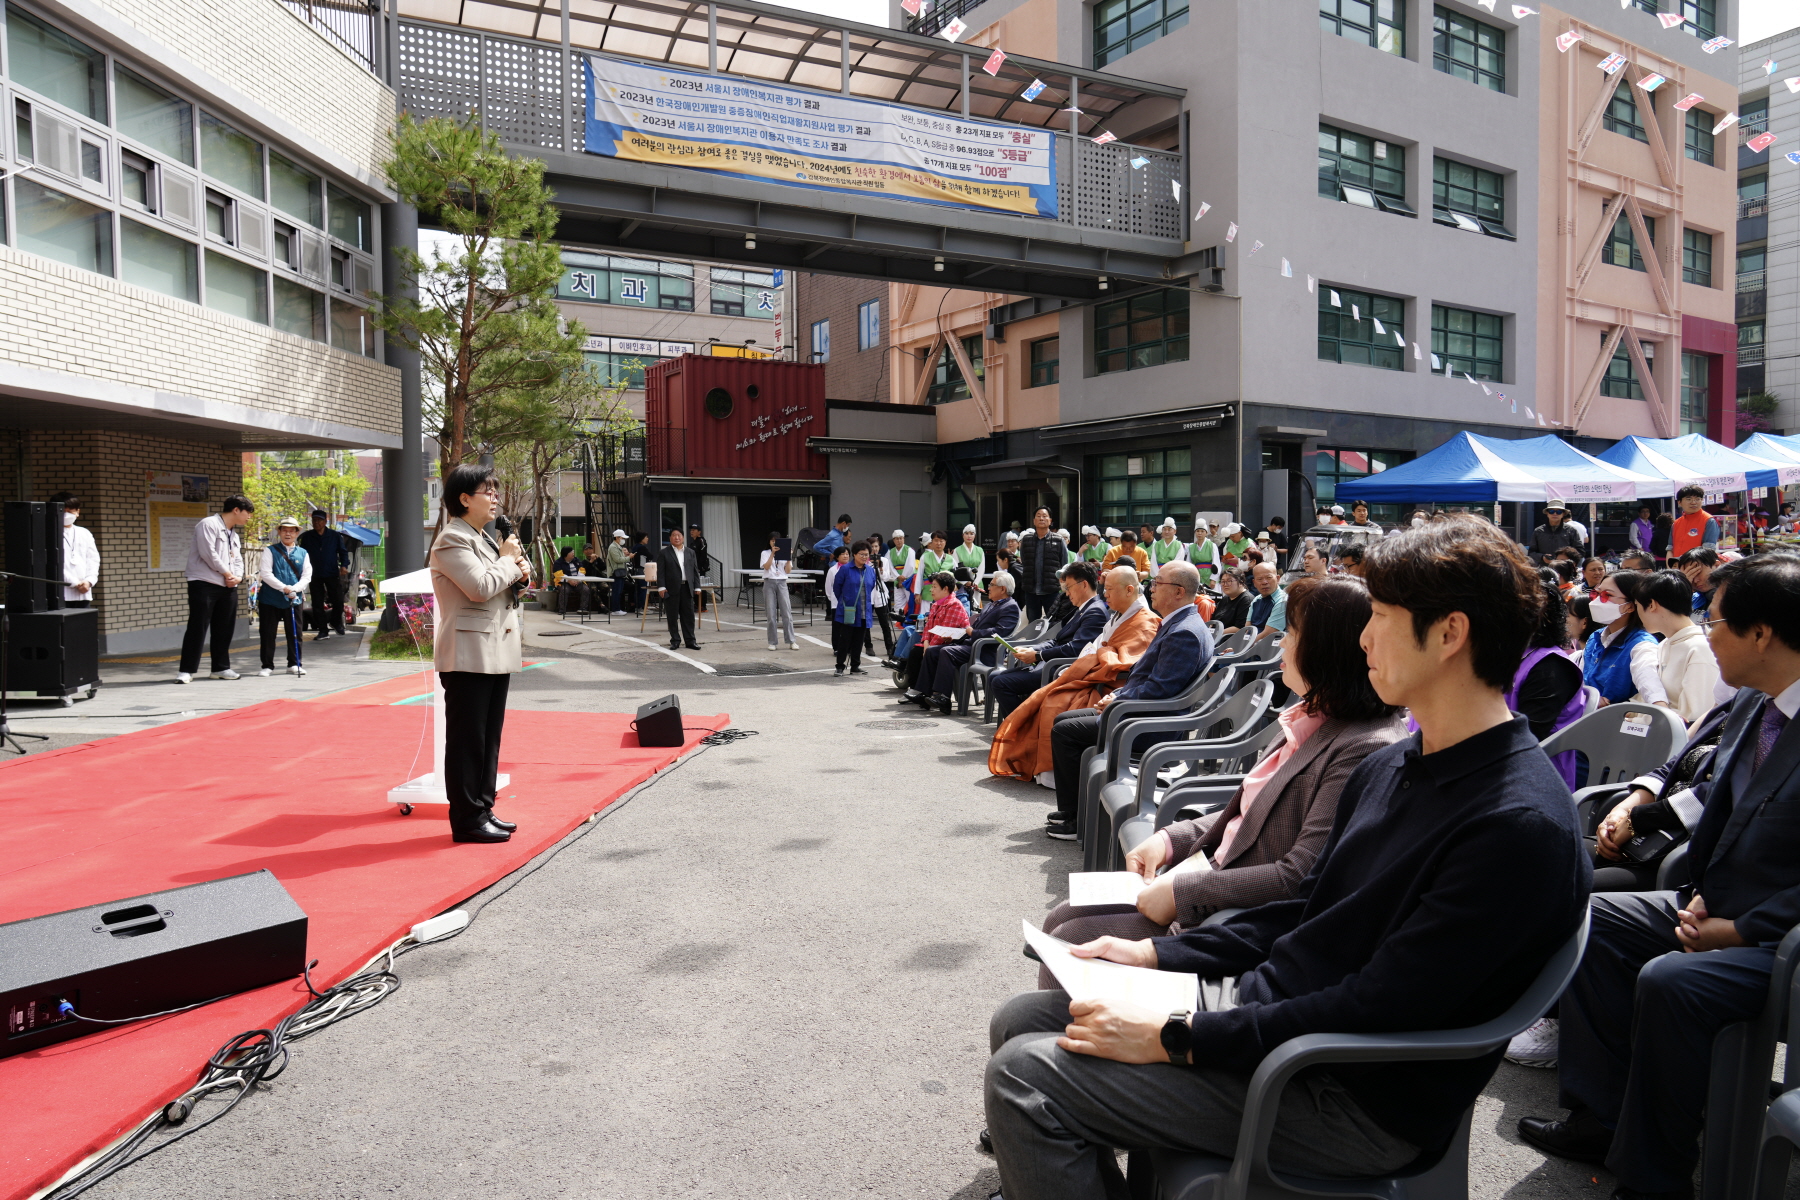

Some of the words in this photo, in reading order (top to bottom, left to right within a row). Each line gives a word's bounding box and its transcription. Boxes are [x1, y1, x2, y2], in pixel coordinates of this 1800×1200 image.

[670, 79, 702, 92] 2023년
[706, 84, 730, 95] 서울시
[732, 87, 783, 104] 장애인복지관
[785, 96, 802, 107] 평가
[804, 100, 820, 110] 결과
[620, 91, 654, 105] 2023년
[656, 97, 726, 114] 한국장애인개발원
[729, 106, 835, 132] 중증장애인직업재활지원사업
[838, 124, 853, 134] 평가
[855, 126, 871, 136] 결과
[642, 115, 675, 129] 2023년
[678, 121, 704, 132] 서울시
[706, 124, 757, 138] 장애인복지관
[760, 130, 785, 142] 이용자
[786, 135, 810, 147] 만족도
[813, 140, 829, 150] 조사
[831, 142, 847, 152] 결과
[956, 126, 962, 134] 총
[963, 128, 978, 136] 23개
[980, 129, 991, 138] 지표
[992, 132, 1004, 140] 모두
[956, 146, 994, 158] 96.93점으로
[632, 138, 664, 152] 여러분의
[667, 142, 693, 154] 관심과
[697, 146, 721, 157] 참여로
[725, 148, 737, 160] 좋은
[740, 150, 762, 164] 결실을
[810, 162, 852, 175] 2024년에도
[855, 167, 876, 178] 친숙한
[879, 168, 911, 181] 환경에서
[964, 184, 980, 195] 함께
[930, 159, 944, 168] 17개
[946, 162, 958, 170] 지표
[960, 164, 972, 172] 모두
[620, 342, 652, 352] 이비인후과
[668, 345, 688, 354] 피부과
